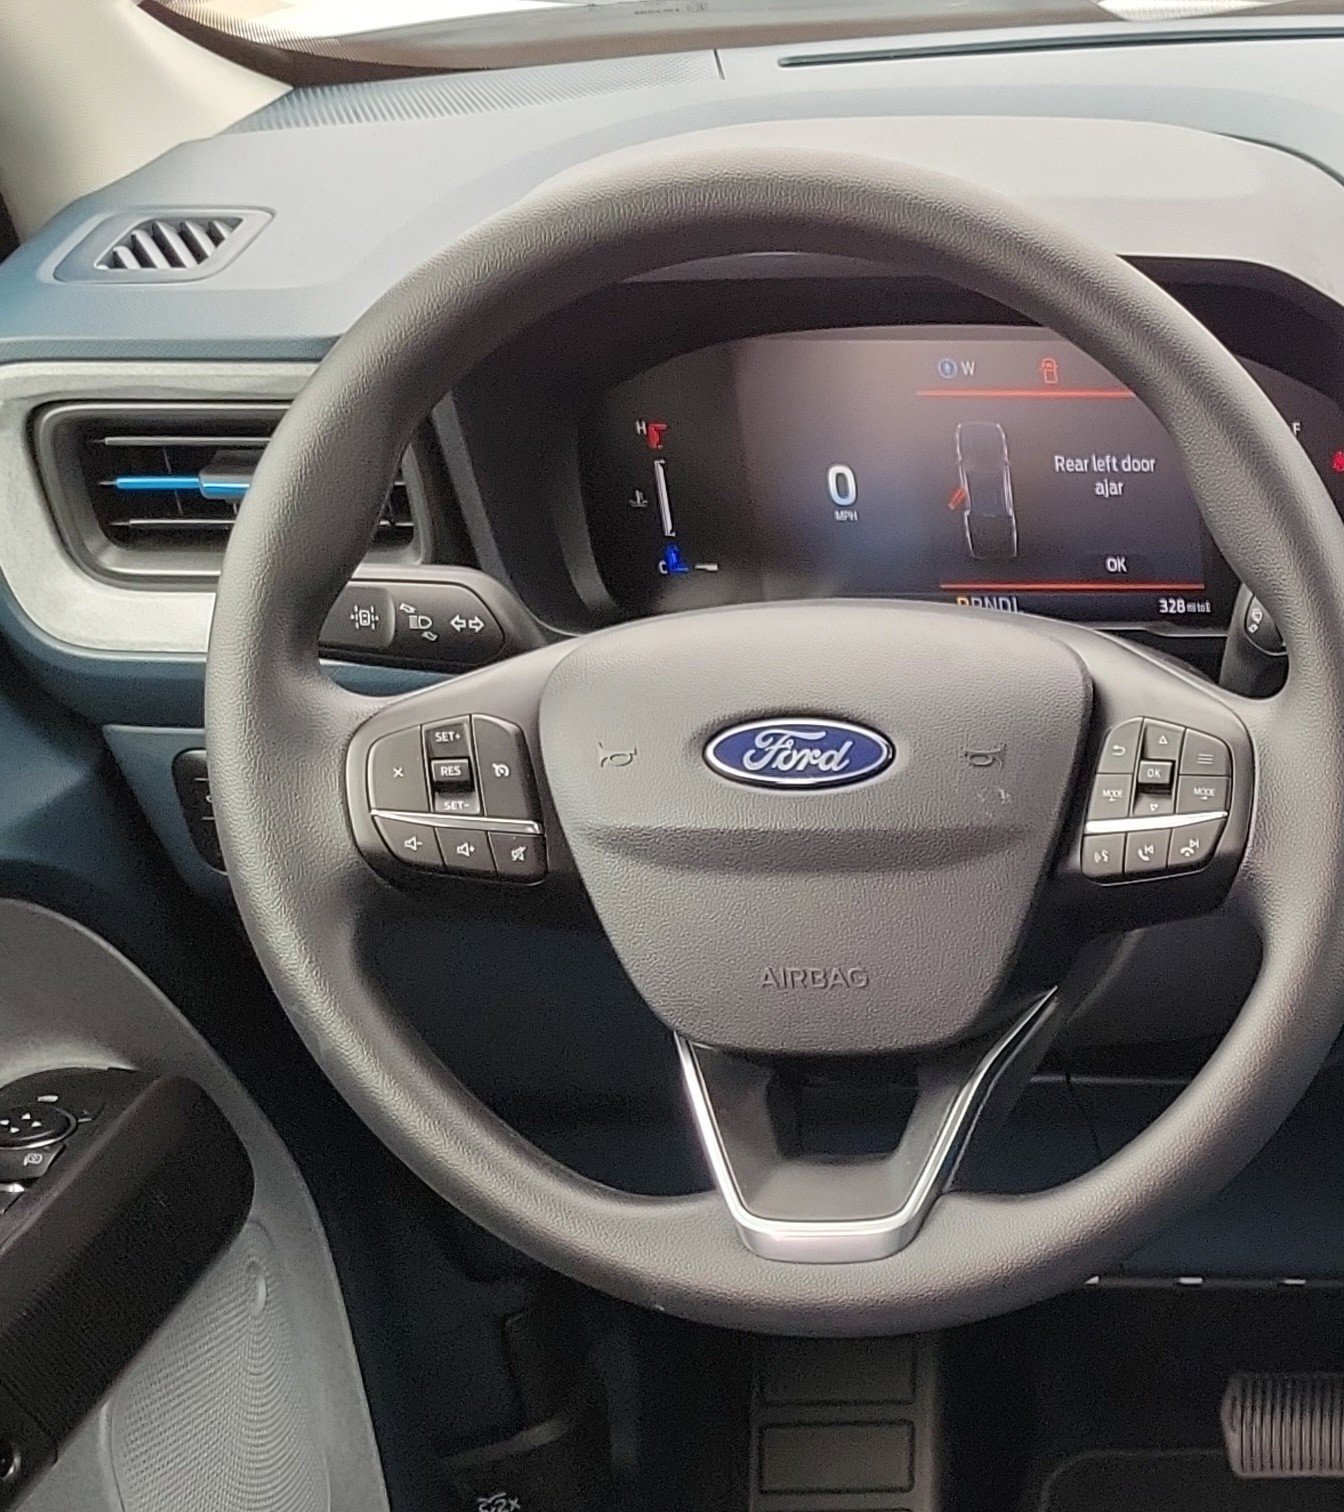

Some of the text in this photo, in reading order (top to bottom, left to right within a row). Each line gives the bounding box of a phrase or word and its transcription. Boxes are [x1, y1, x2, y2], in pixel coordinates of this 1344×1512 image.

[961, 361, 976, 376] W
[636, 420, 647, 435] H
[1054, 454, 1156, 474] Rear left door
[827, 464, 859, 507] 0
[1095, 478, 1124, 500] ajar
[835, 510, 859, 522] MPH
[1106, 556, 1129, 573] OK
[1159, 599, 1186, 614] 328
[743, 729, 851, 774] Ford
[440, 765, 461, 776] RES
[1147, 768, 1161, 778] OK
[1103, 789, 1124, 798] MODE
[1193, 787, 1216, 797] MODE
[761, 966, 869, 989] AIRBAG
